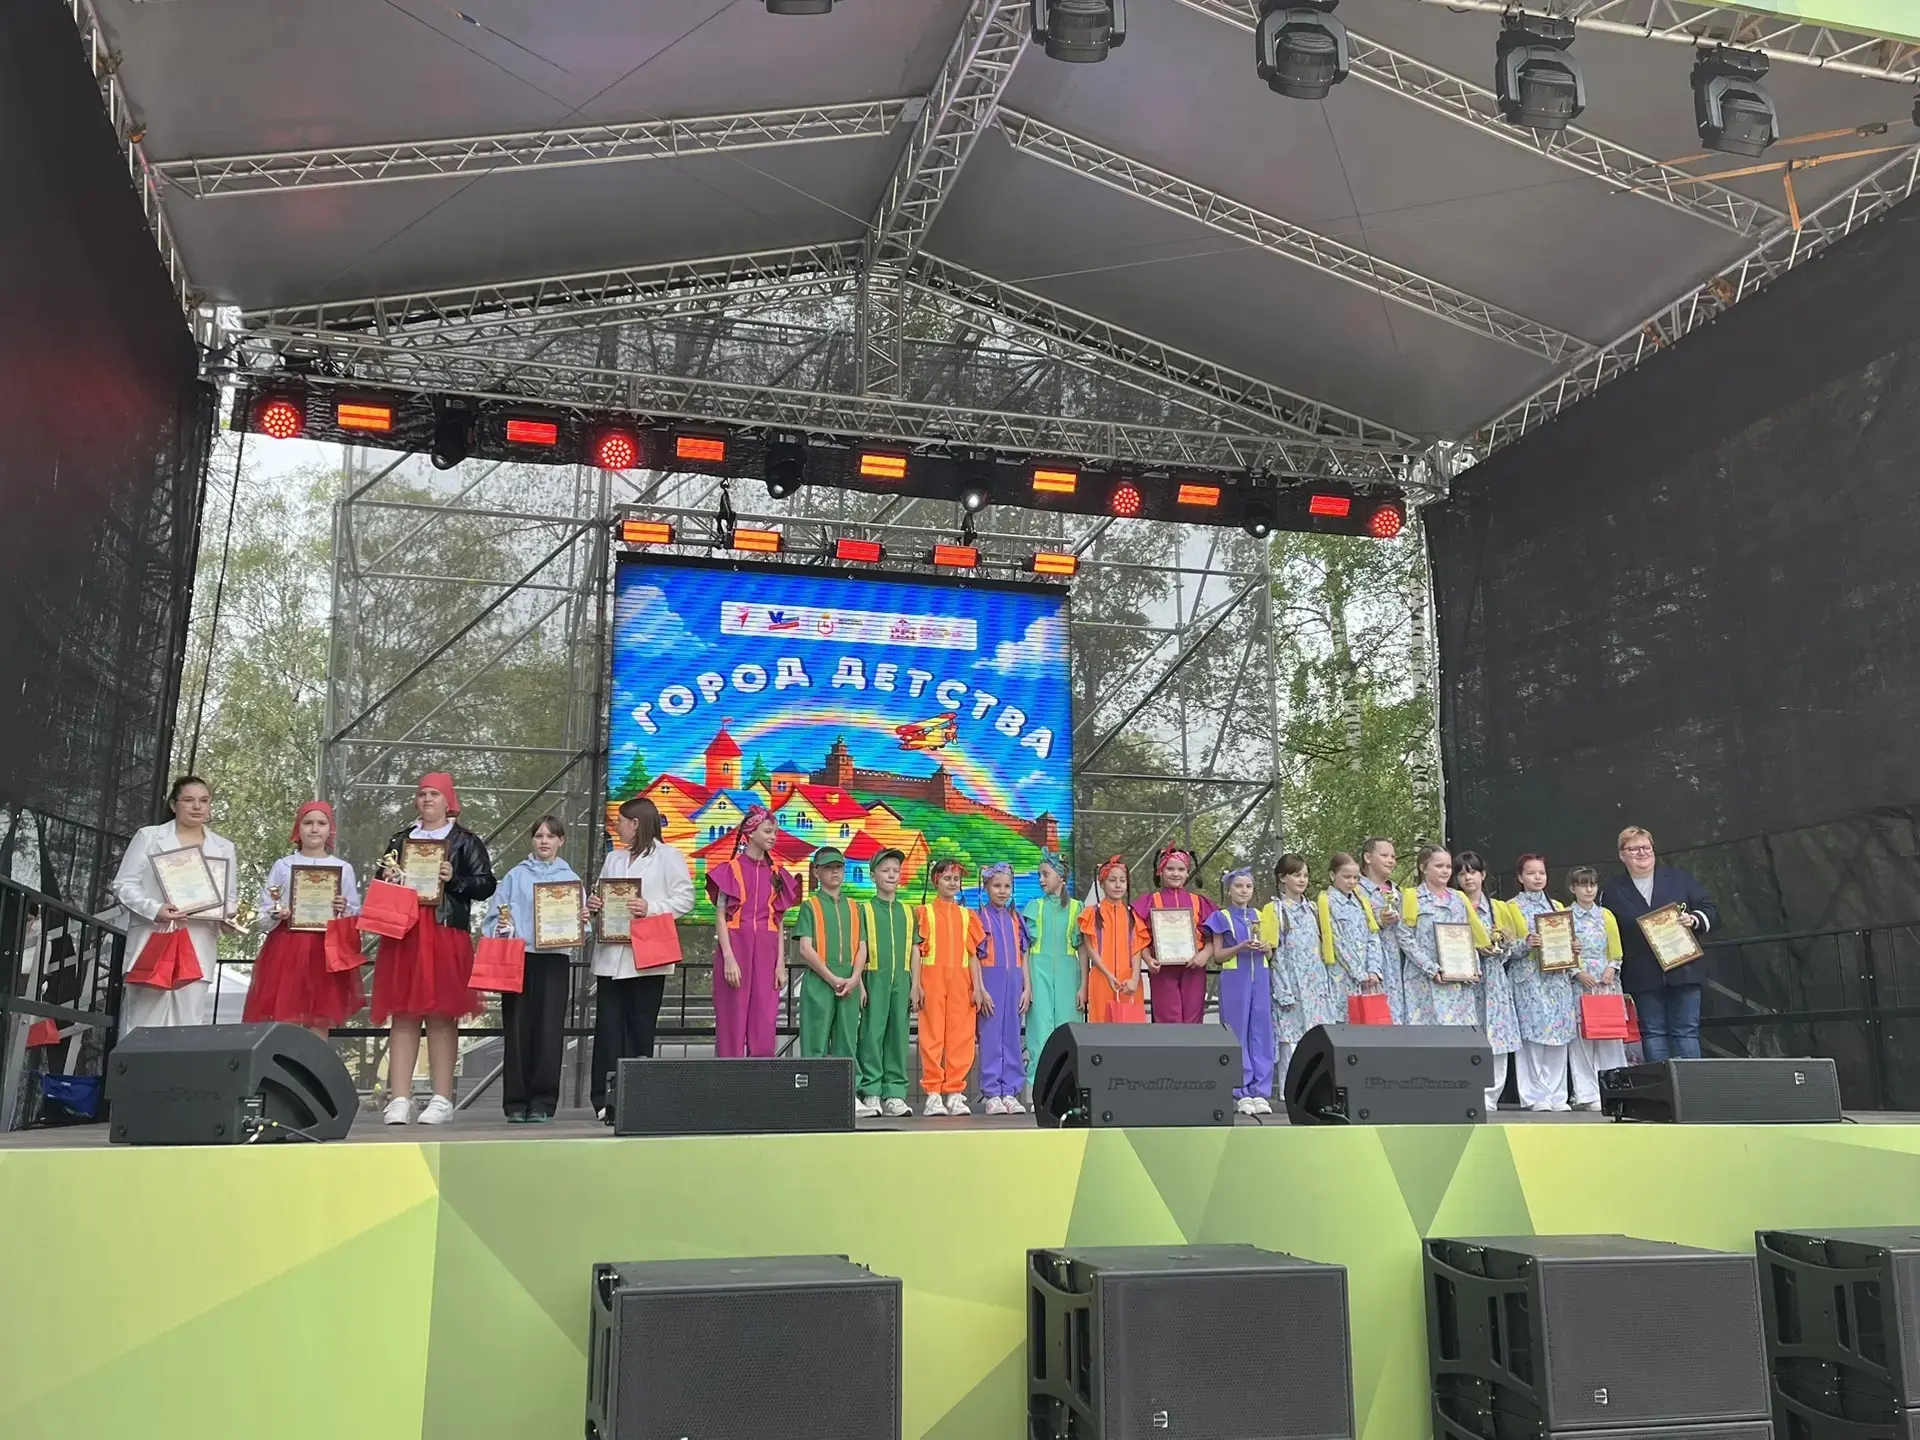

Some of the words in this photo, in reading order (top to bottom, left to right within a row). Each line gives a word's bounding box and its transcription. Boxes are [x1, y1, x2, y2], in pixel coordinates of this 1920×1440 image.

[631, 657, 812, 735] ГОРОД
[831, 656, 1054, 759] ДЕТСТВА
[1107, 1077, 1218, 1091] ProTone
